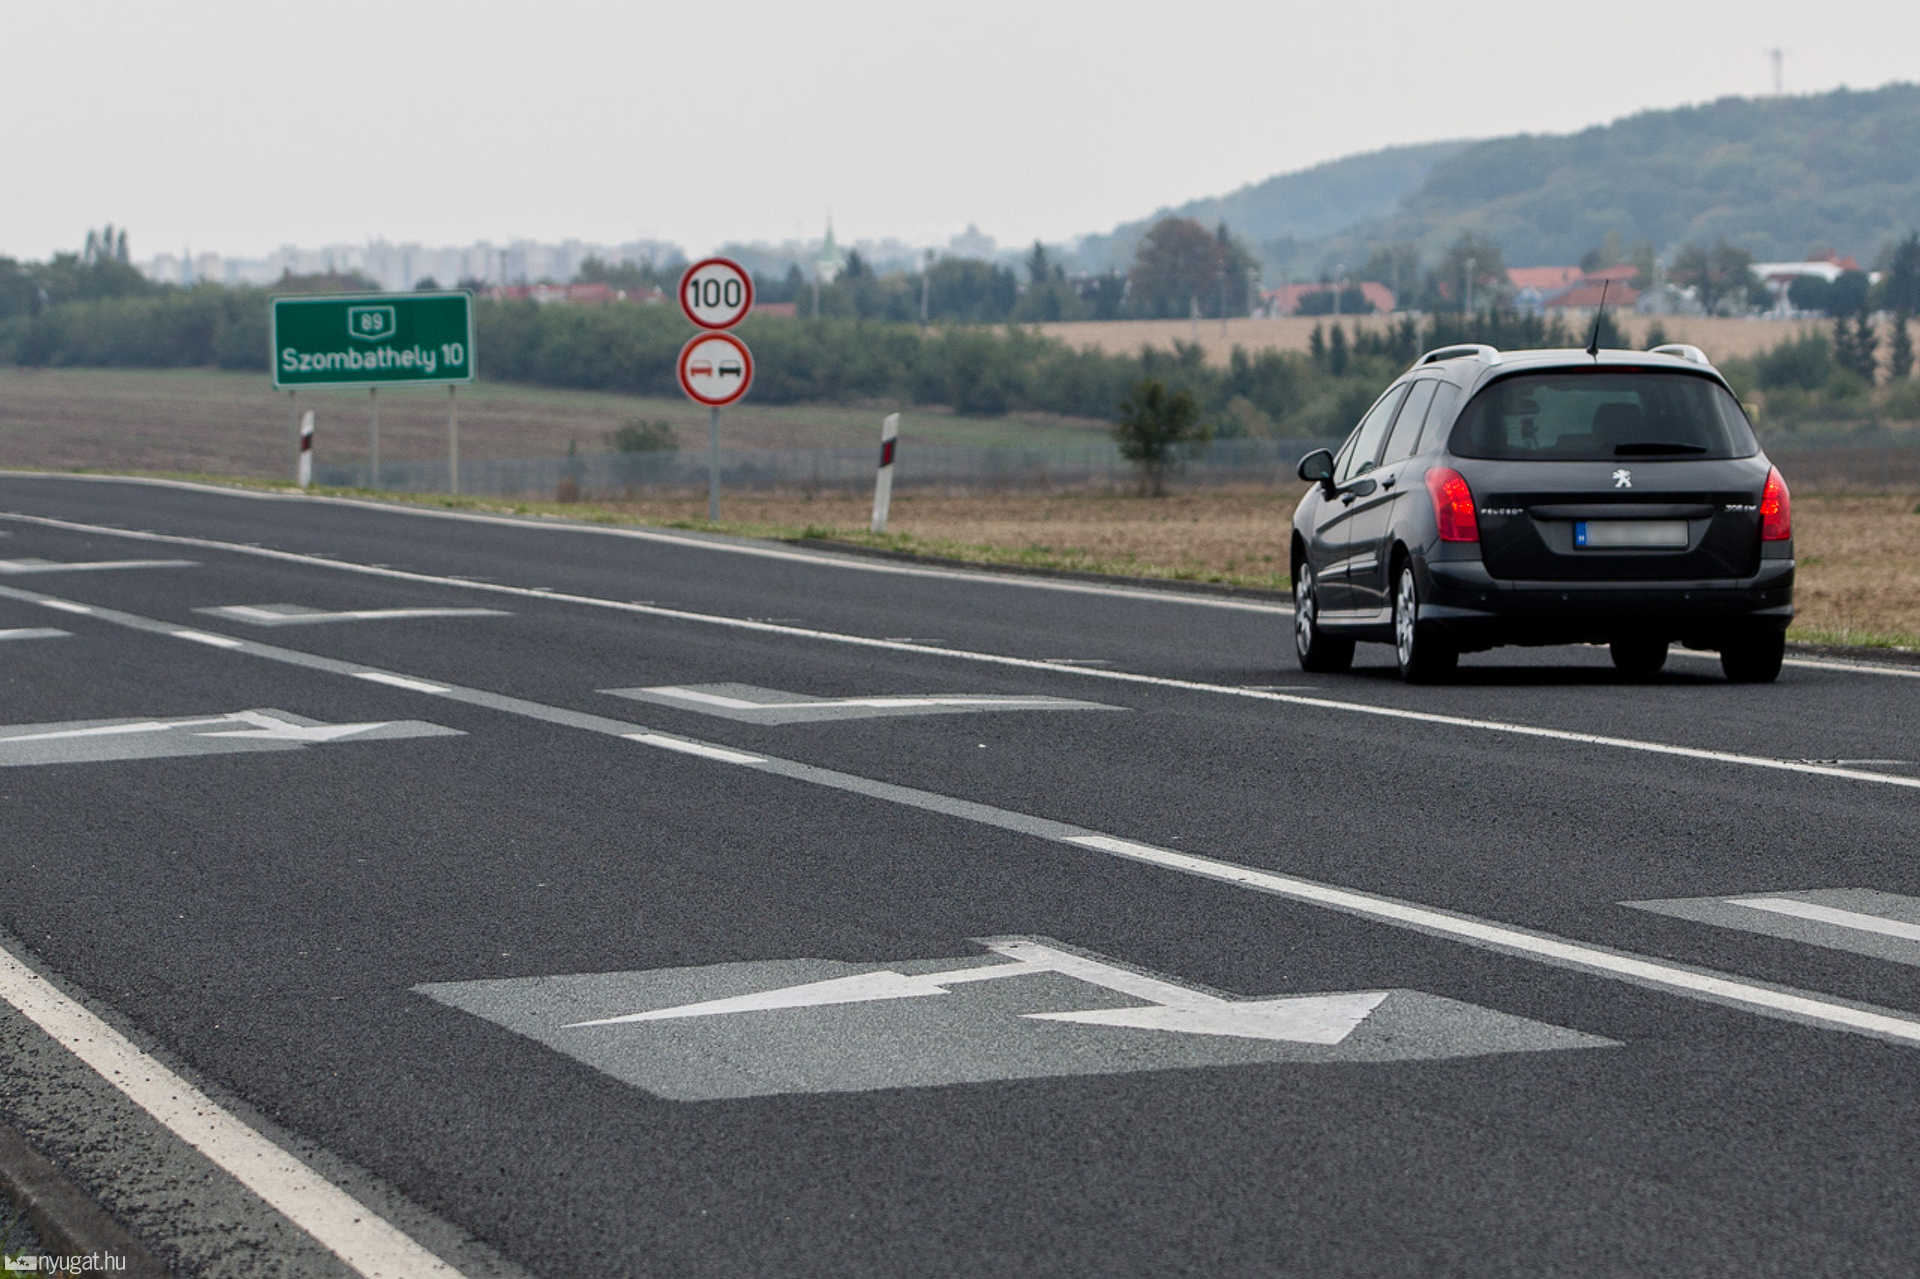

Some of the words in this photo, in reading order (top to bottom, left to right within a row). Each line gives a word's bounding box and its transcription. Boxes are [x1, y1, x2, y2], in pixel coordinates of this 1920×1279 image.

[691, 278, 741, 308] 100
[361, 313, 384, 331] 89
[282, 344, 436, 373] Szombathely
[441, 343, 464, 366] 10
